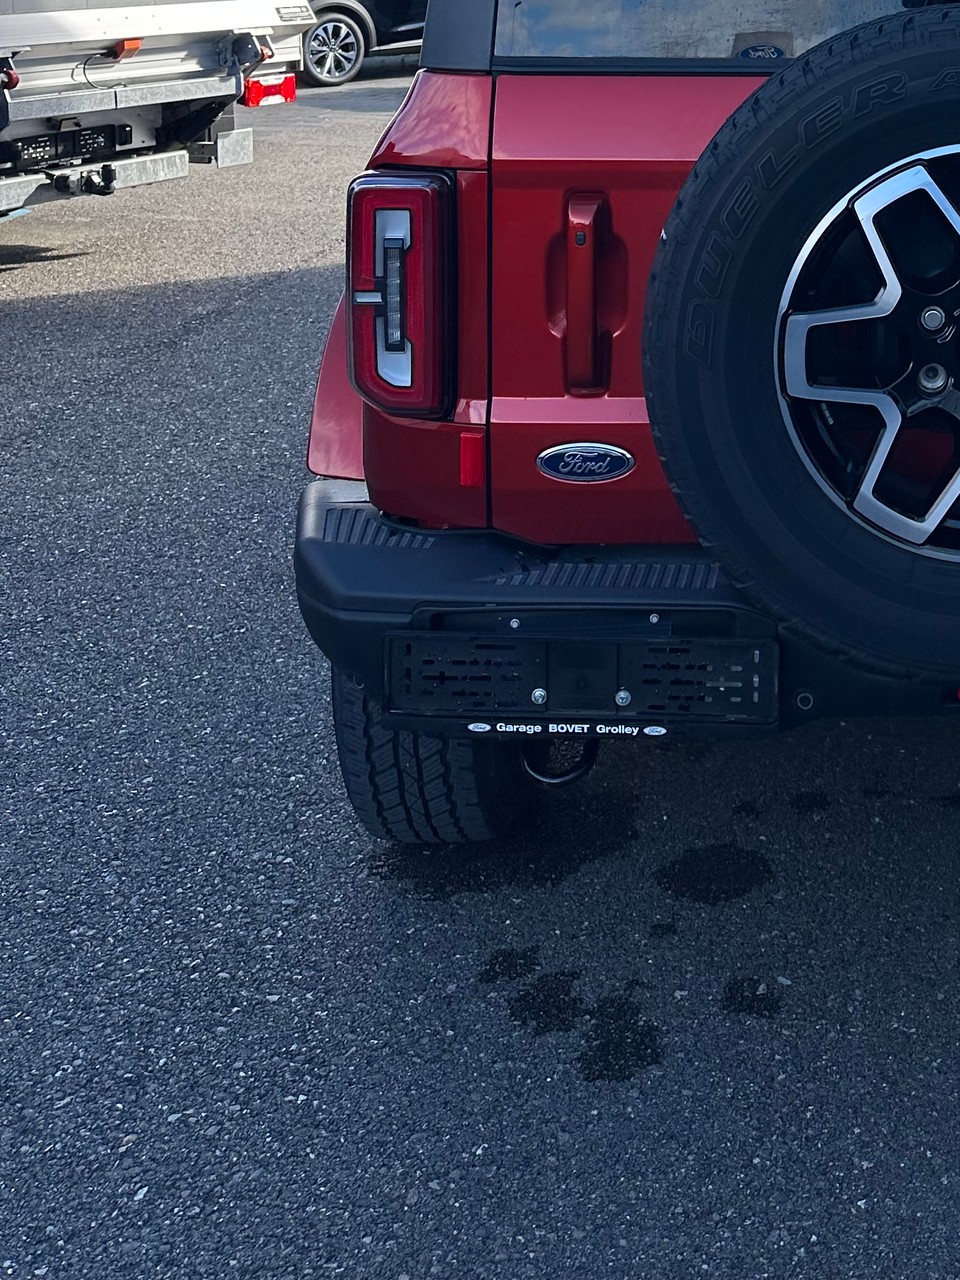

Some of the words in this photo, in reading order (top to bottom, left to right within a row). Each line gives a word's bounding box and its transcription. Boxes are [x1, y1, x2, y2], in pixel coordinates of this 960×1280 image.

[682, 72, 909, 370] DUELER
[558, 451, 611, 474] Ford
[496, 722, 542, 734] Garage
[548, 724, 590, 733] BOVET
[596, 724, 640, 736] Grolley
